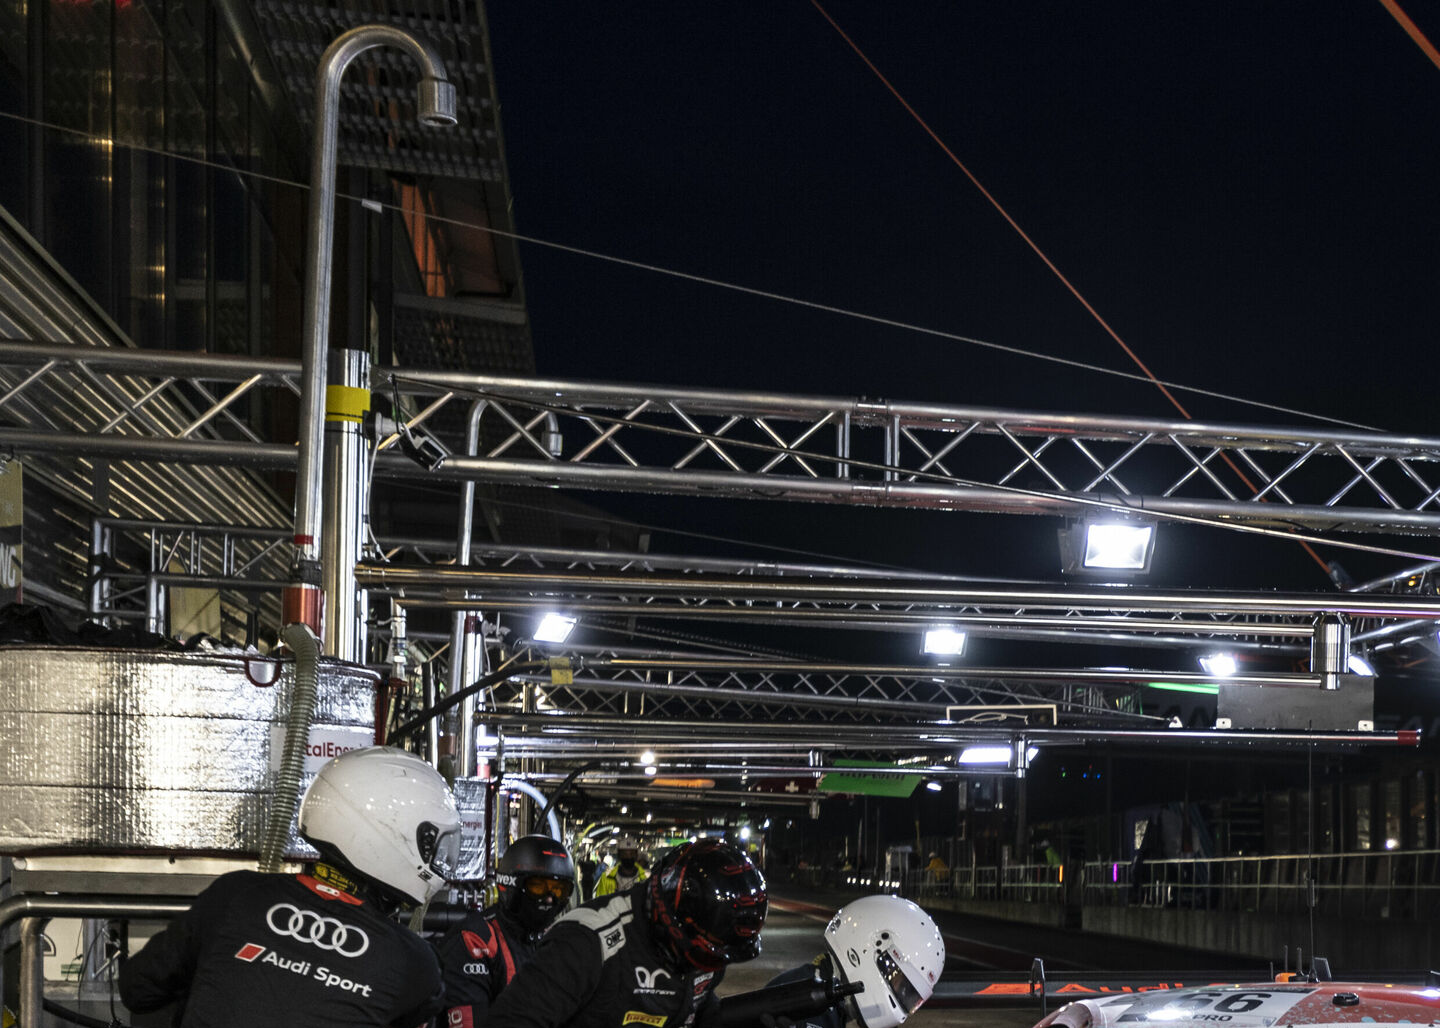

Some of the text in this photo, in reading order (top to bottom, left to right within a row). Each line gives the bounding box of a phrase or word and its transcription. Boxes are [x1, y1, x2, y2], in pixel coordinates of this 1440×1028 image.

[262, 951, 373, 998] Audi Sport
[1193, 1013, 1233, 1022] PRO
